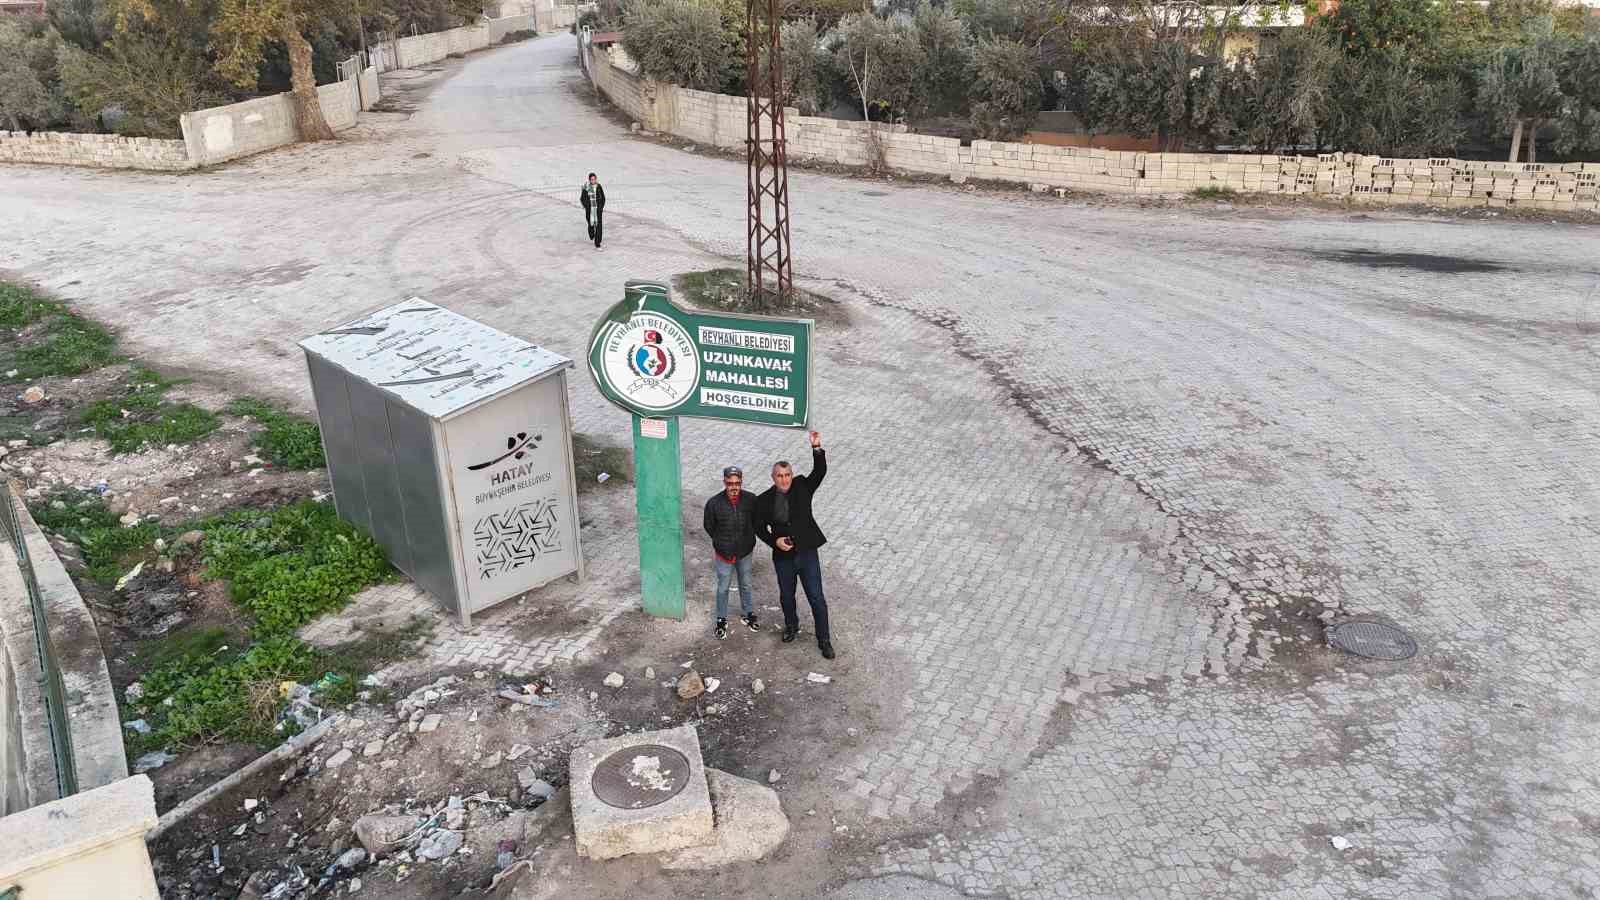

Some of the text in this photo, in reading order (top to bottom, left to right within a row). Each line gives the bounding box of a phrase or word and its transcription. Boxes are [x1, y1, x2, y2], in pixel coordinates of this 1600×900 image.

[702, 330, 791, 352] REYHANLI BELEDİYESİ
[703, 350, 793, 372] UZUNKAVAK
[705, 369, 789, 391] MAHALLESİ
[706, 391, 790, 411] HOŞGELDİNİZ
[490, 462, 533, 486] HATAY
